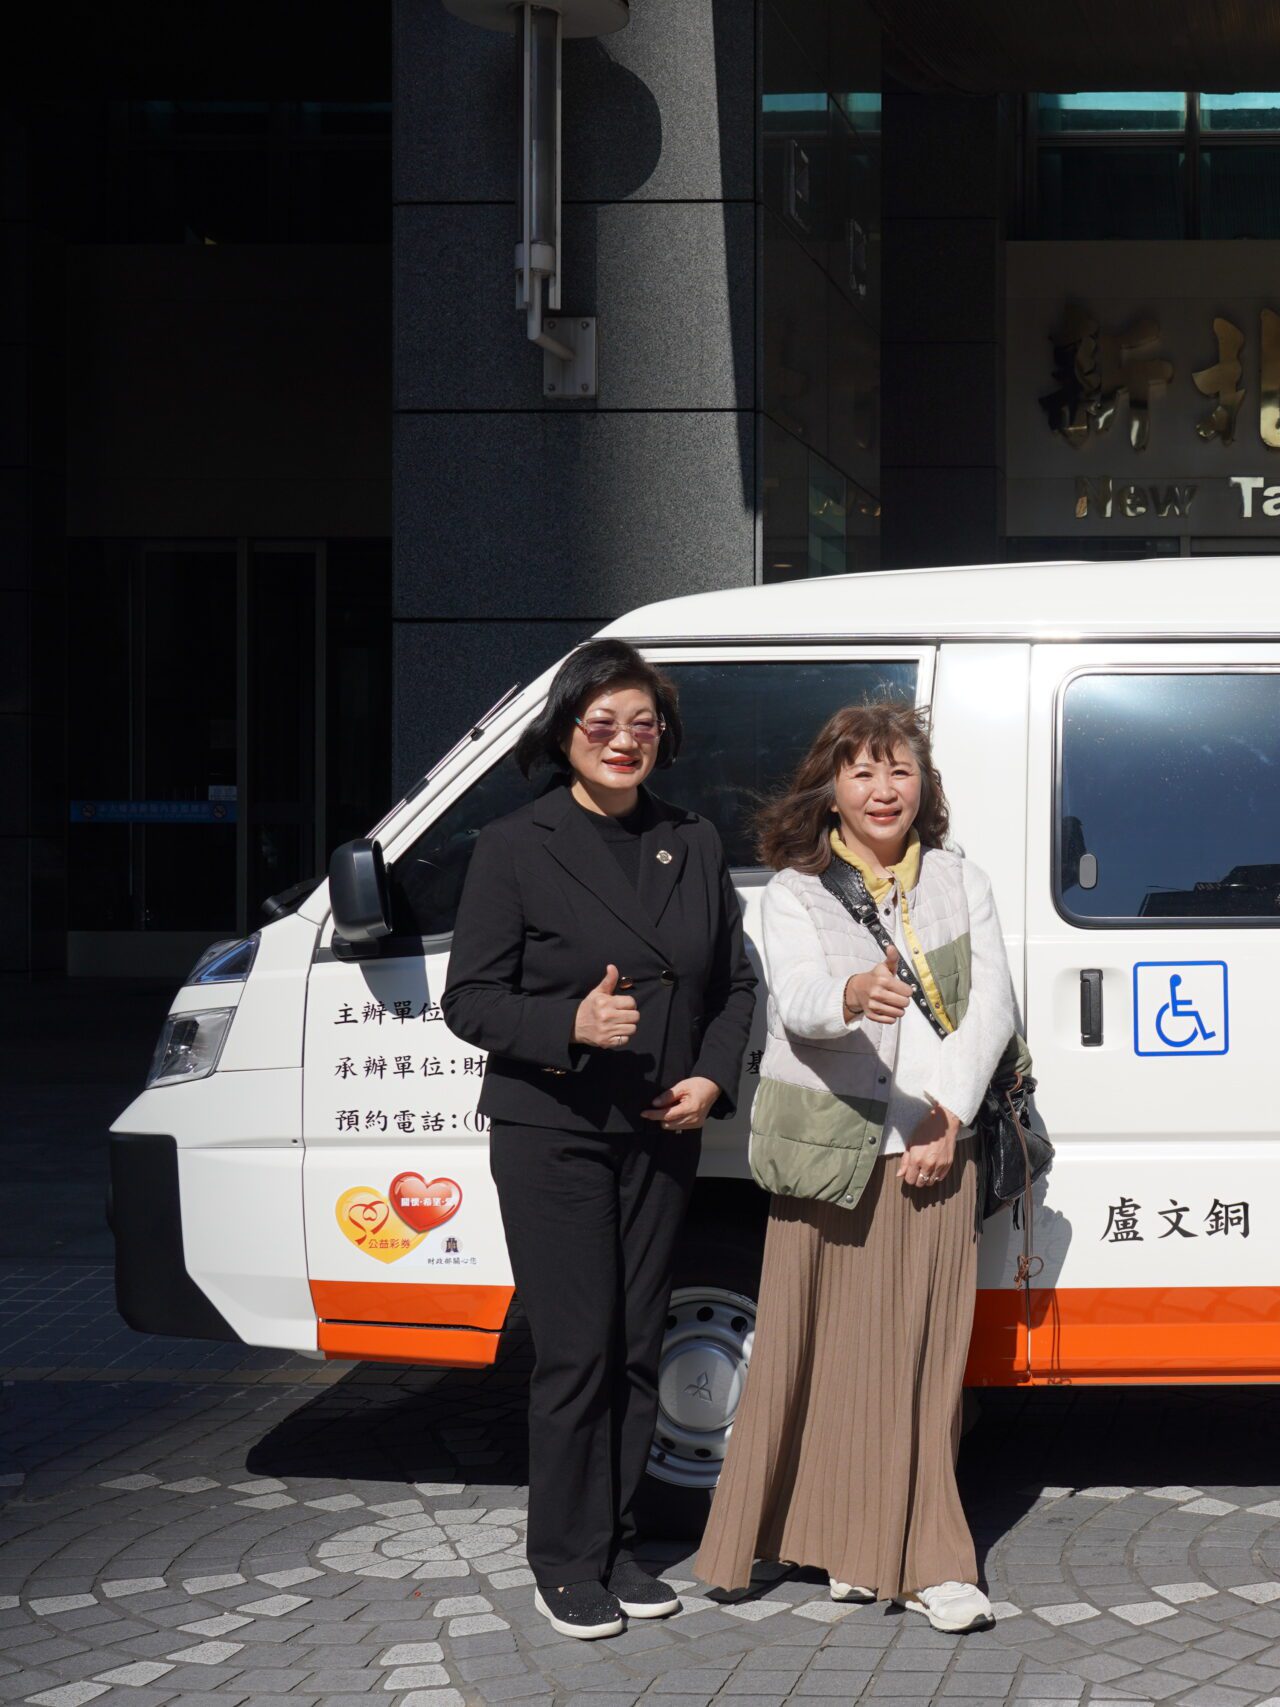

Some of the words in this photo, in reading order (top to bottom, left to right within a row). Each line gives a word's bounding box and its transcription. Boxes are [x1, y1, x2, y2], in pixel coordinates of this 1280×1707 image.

[1075, 475, 1198, 519] New
[333, 1000, 445, 1026] 主辦單位
[1100, 1196, 1250, 1243] 盧文銅
[368, 1238, 411, 1249] 公益彩券
